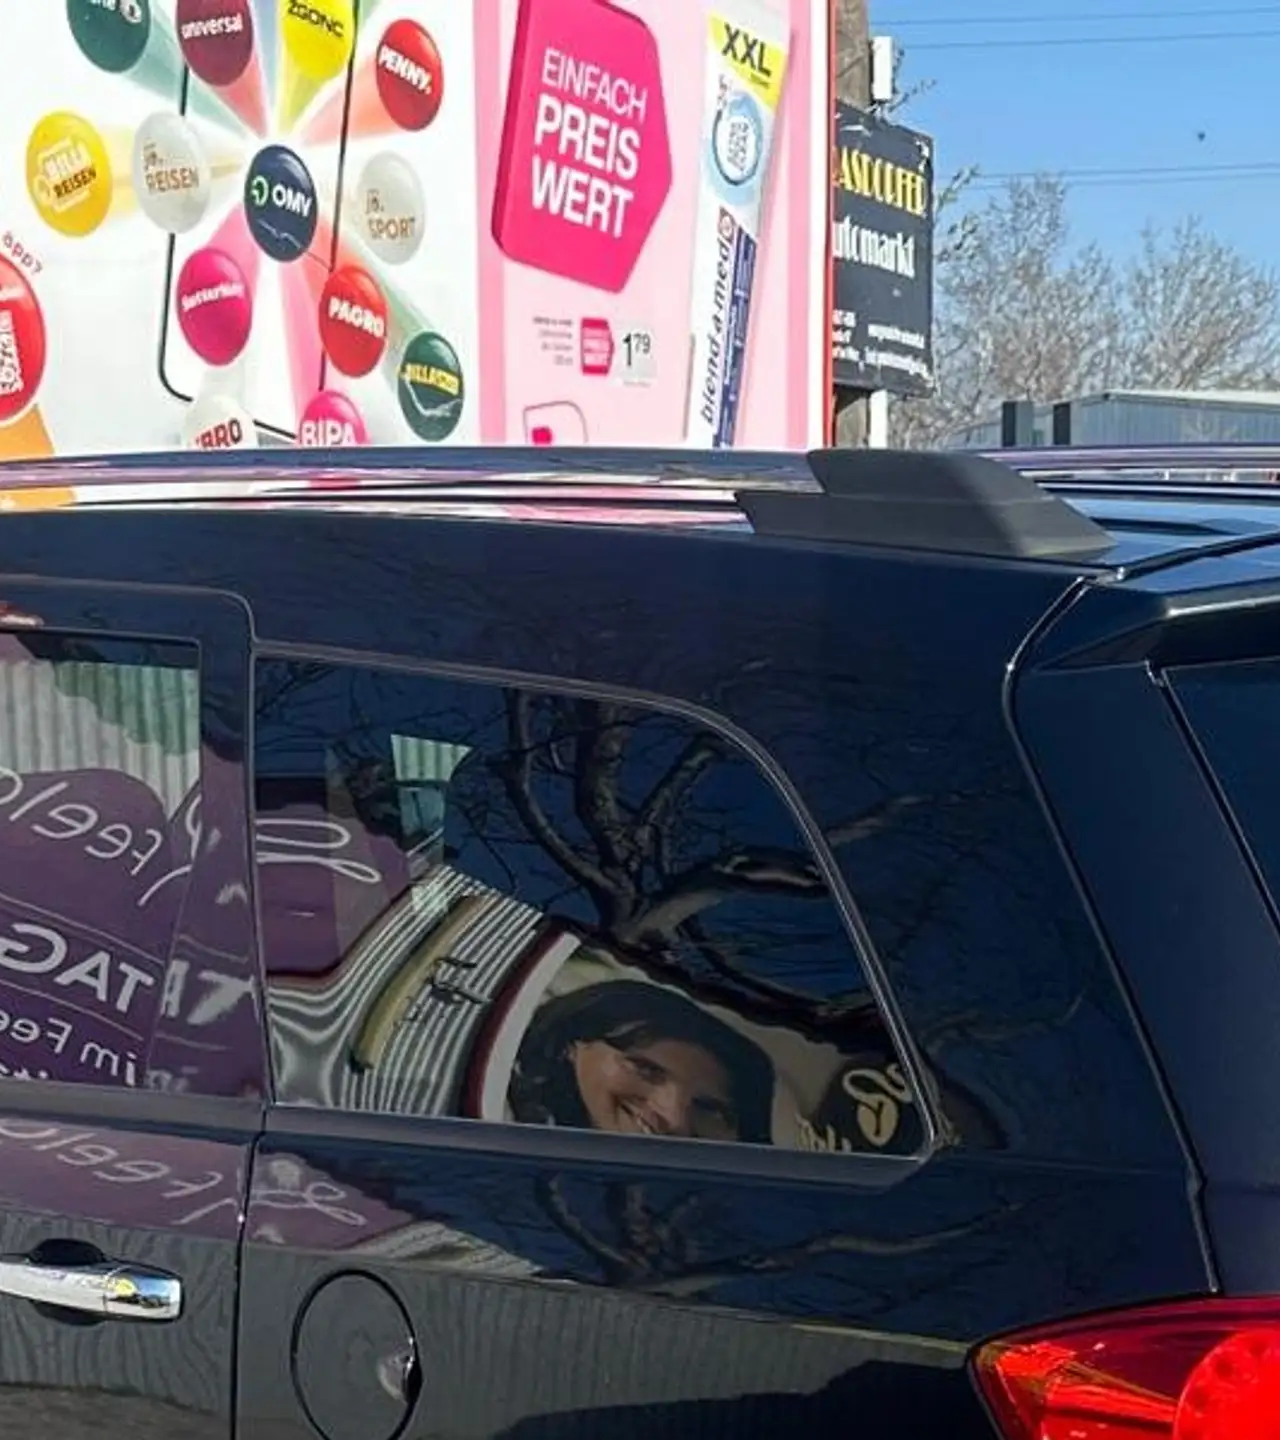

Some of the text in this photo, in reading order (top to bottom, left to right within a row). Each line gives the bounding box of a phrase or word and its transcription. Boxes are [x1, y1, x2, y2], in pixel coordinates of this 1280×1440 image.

[721, 22, 772, 77] XXL
[542, 46, 648, 124] EINFACH
[534, 93, 640, 180] PREIS
[53, 163, 98, 198] REISEN
[145, 166, 200, 195] REISEN
[272, 183, 313, 217] OMV
[532, 154, 634, 238] WERT
[368, 216, 416, 240] SPORT
[329, 297, 384, 338] PAGRO
